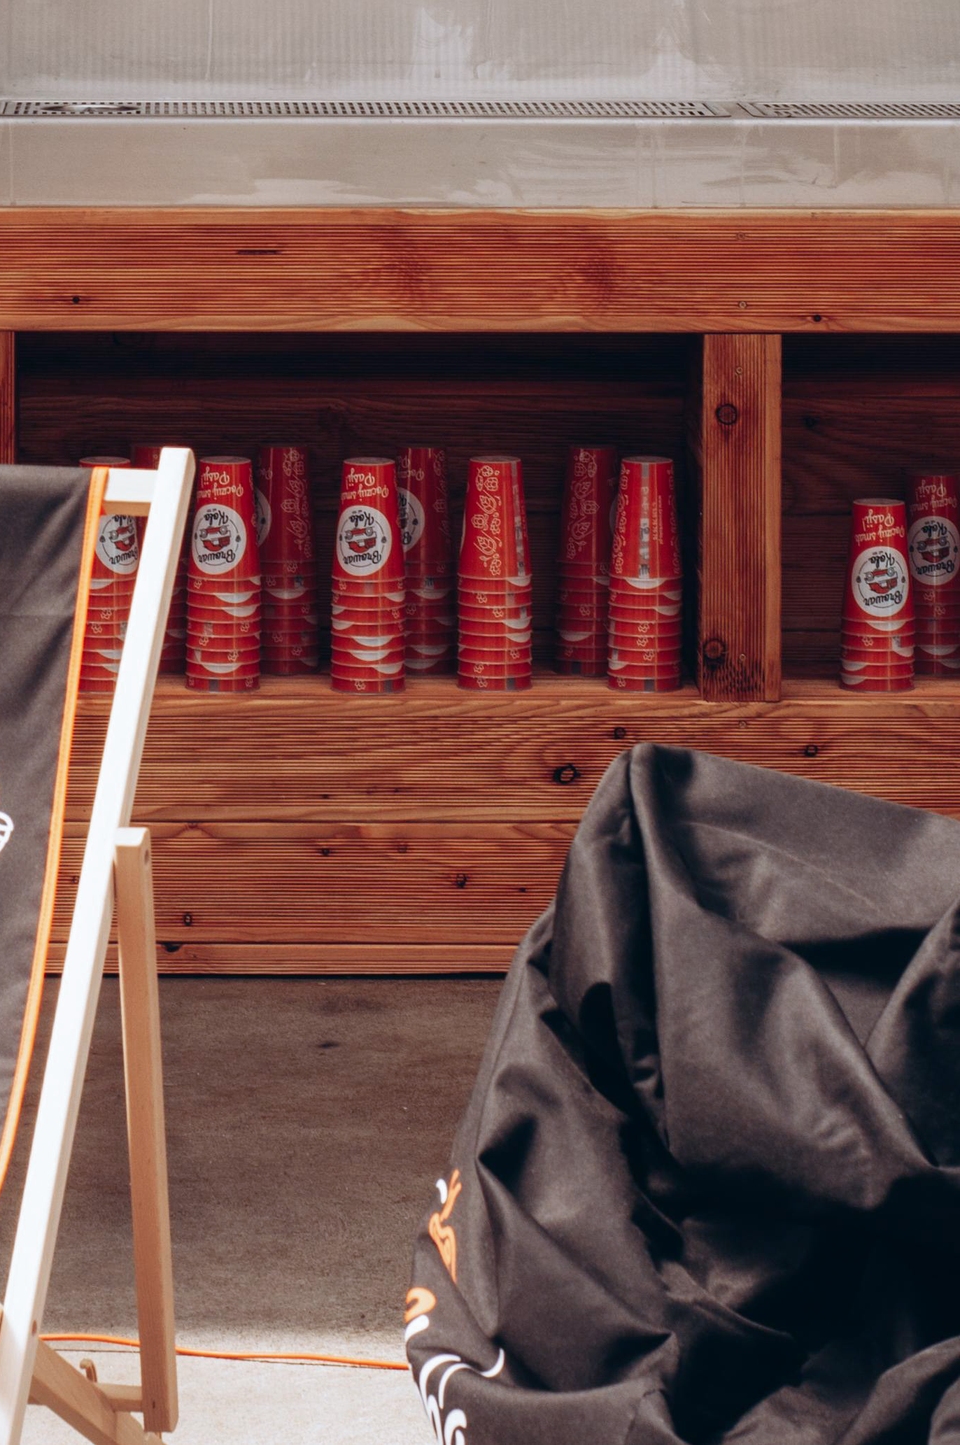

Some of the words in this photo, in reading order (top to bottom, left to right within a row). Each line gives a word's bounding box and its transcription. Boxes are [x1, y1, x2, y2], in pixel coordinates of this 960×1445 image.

[198, 549, 236, 563] Browar
[343, 551, 382, 564] Browar
[915, 560, 955, 575] Browar
[863, 591, 903, 606] Browar
